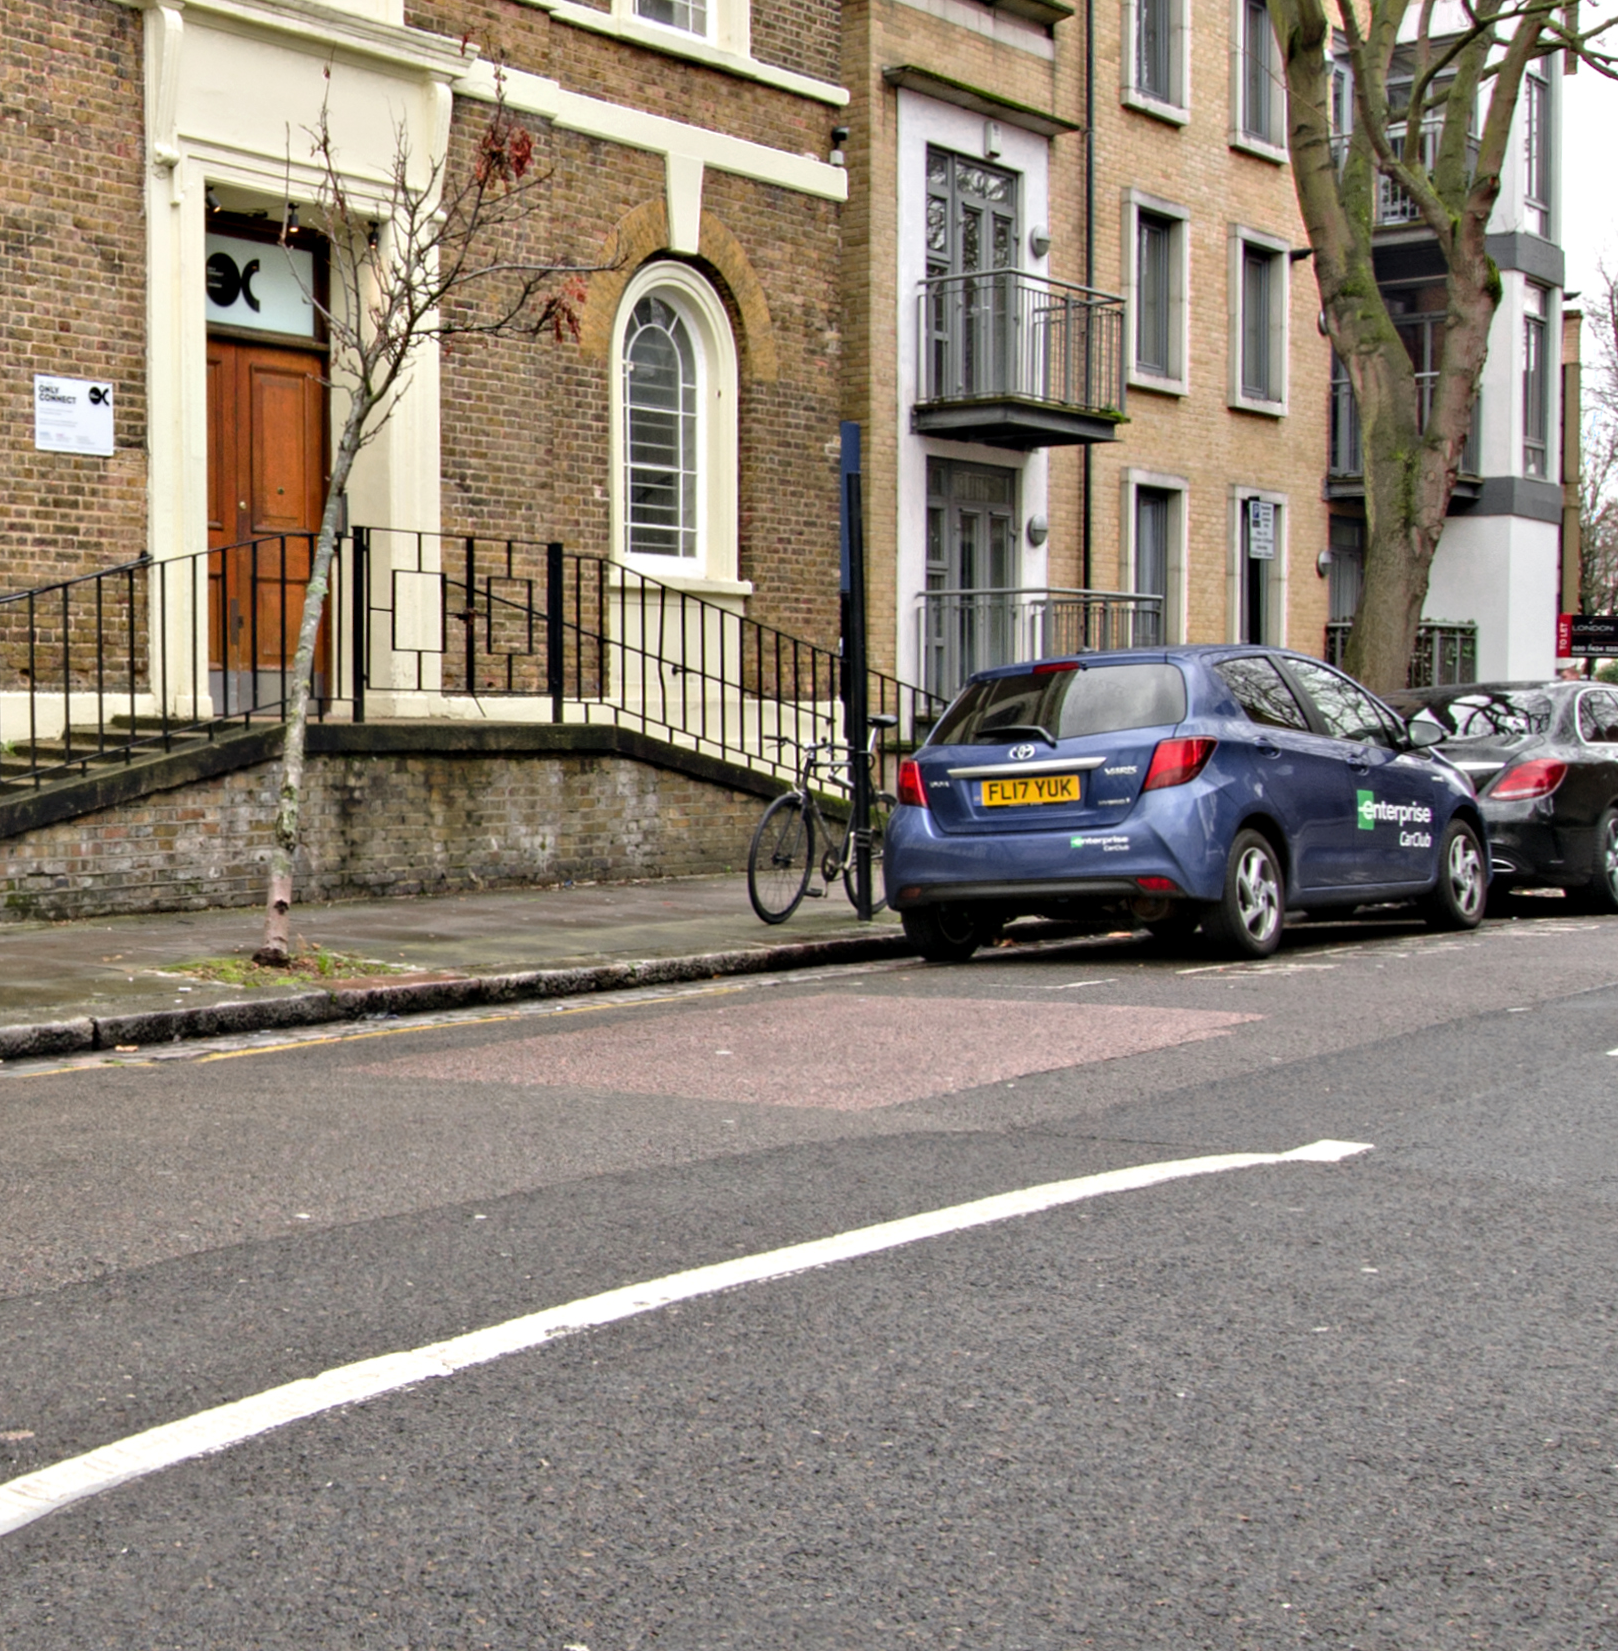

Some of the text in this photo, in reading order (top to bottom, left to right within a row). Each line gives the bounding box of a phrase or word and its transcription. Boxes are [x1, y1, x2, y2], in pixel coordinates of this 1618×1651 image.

[39, 385, 59, 394] ONLY
[38, 393, 77, 404] CONNECT
[988, 778, 1072, 801] FL17 YUK
[1358, 800, 1432, 827] enterprise
[1071, 835, 1129, 846] enterprise
[1399, 831, 1432, 848] CarClub
